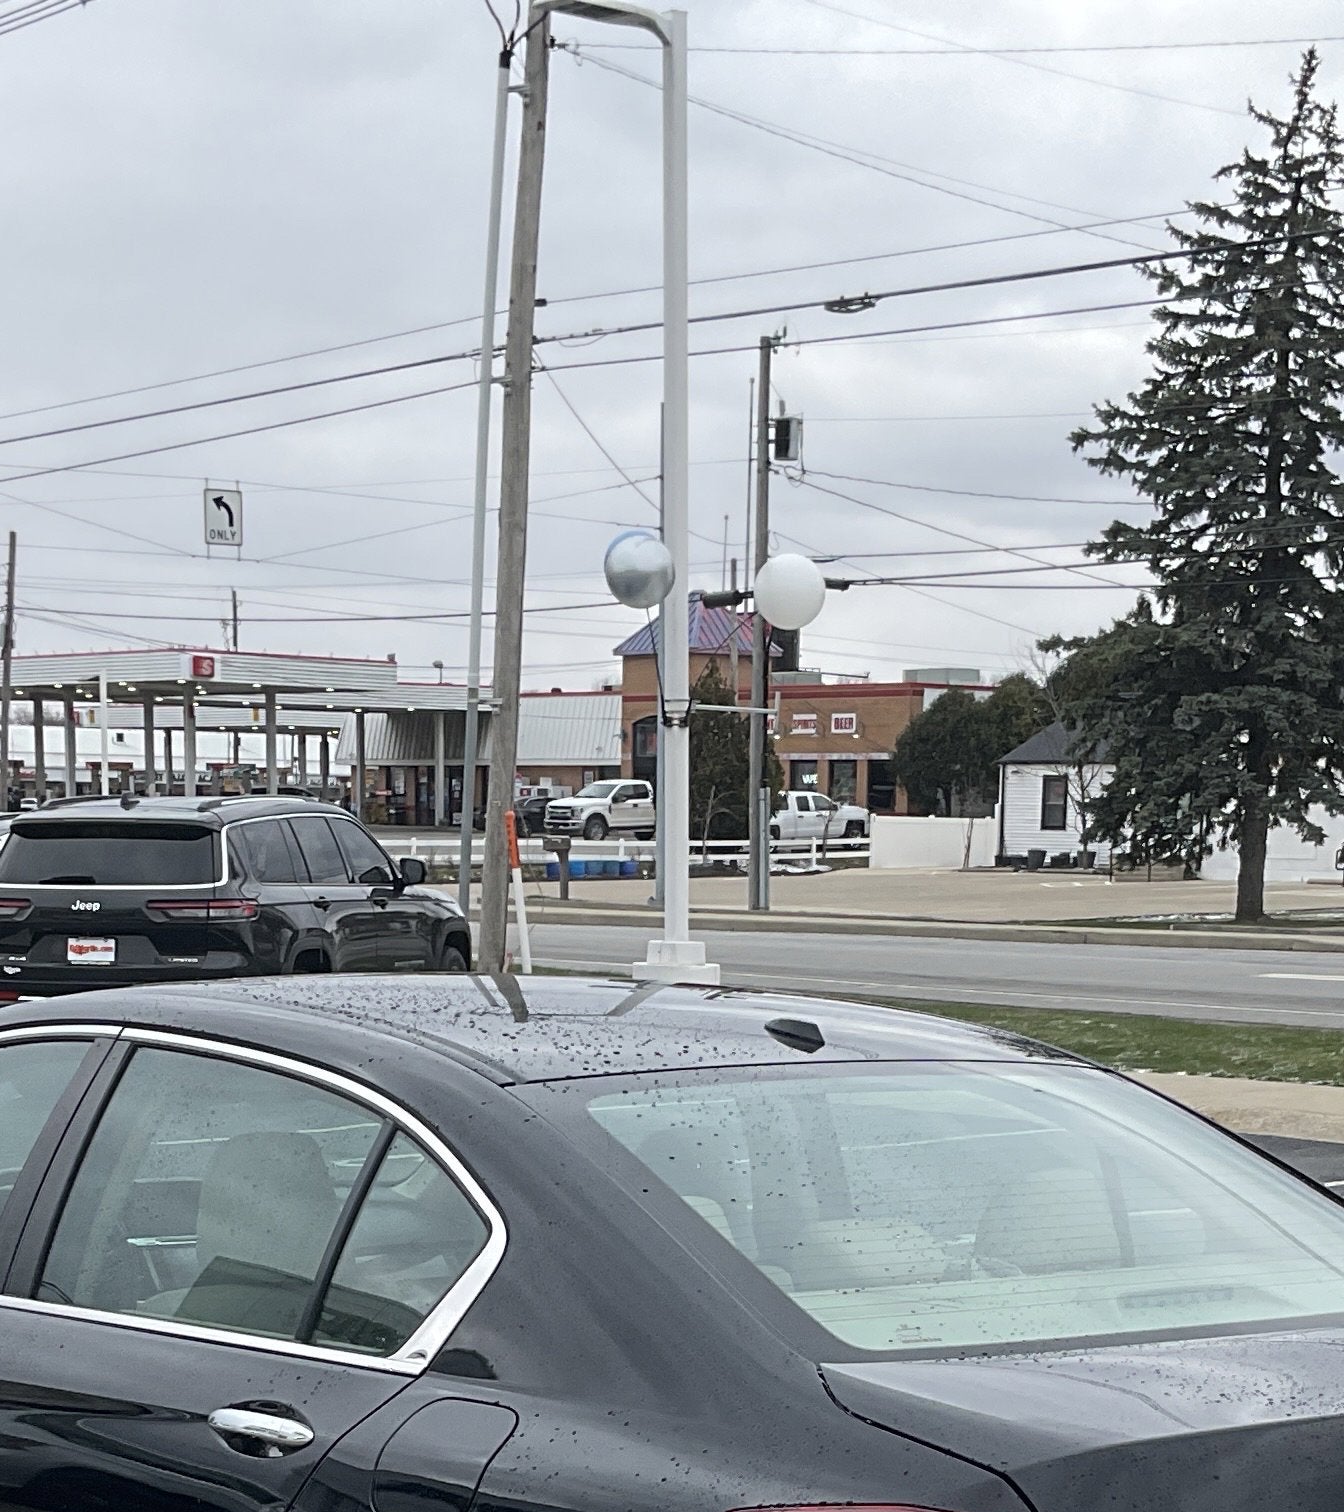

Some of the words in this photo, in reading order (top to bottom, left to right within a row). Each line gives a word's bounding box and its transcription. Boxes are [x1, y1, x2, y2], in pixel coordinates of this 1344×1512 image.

[209, 528, 237, 541] ONLY
[833, 716, 854, 730] BEER
[71, 900, 101, 912] Jeep
